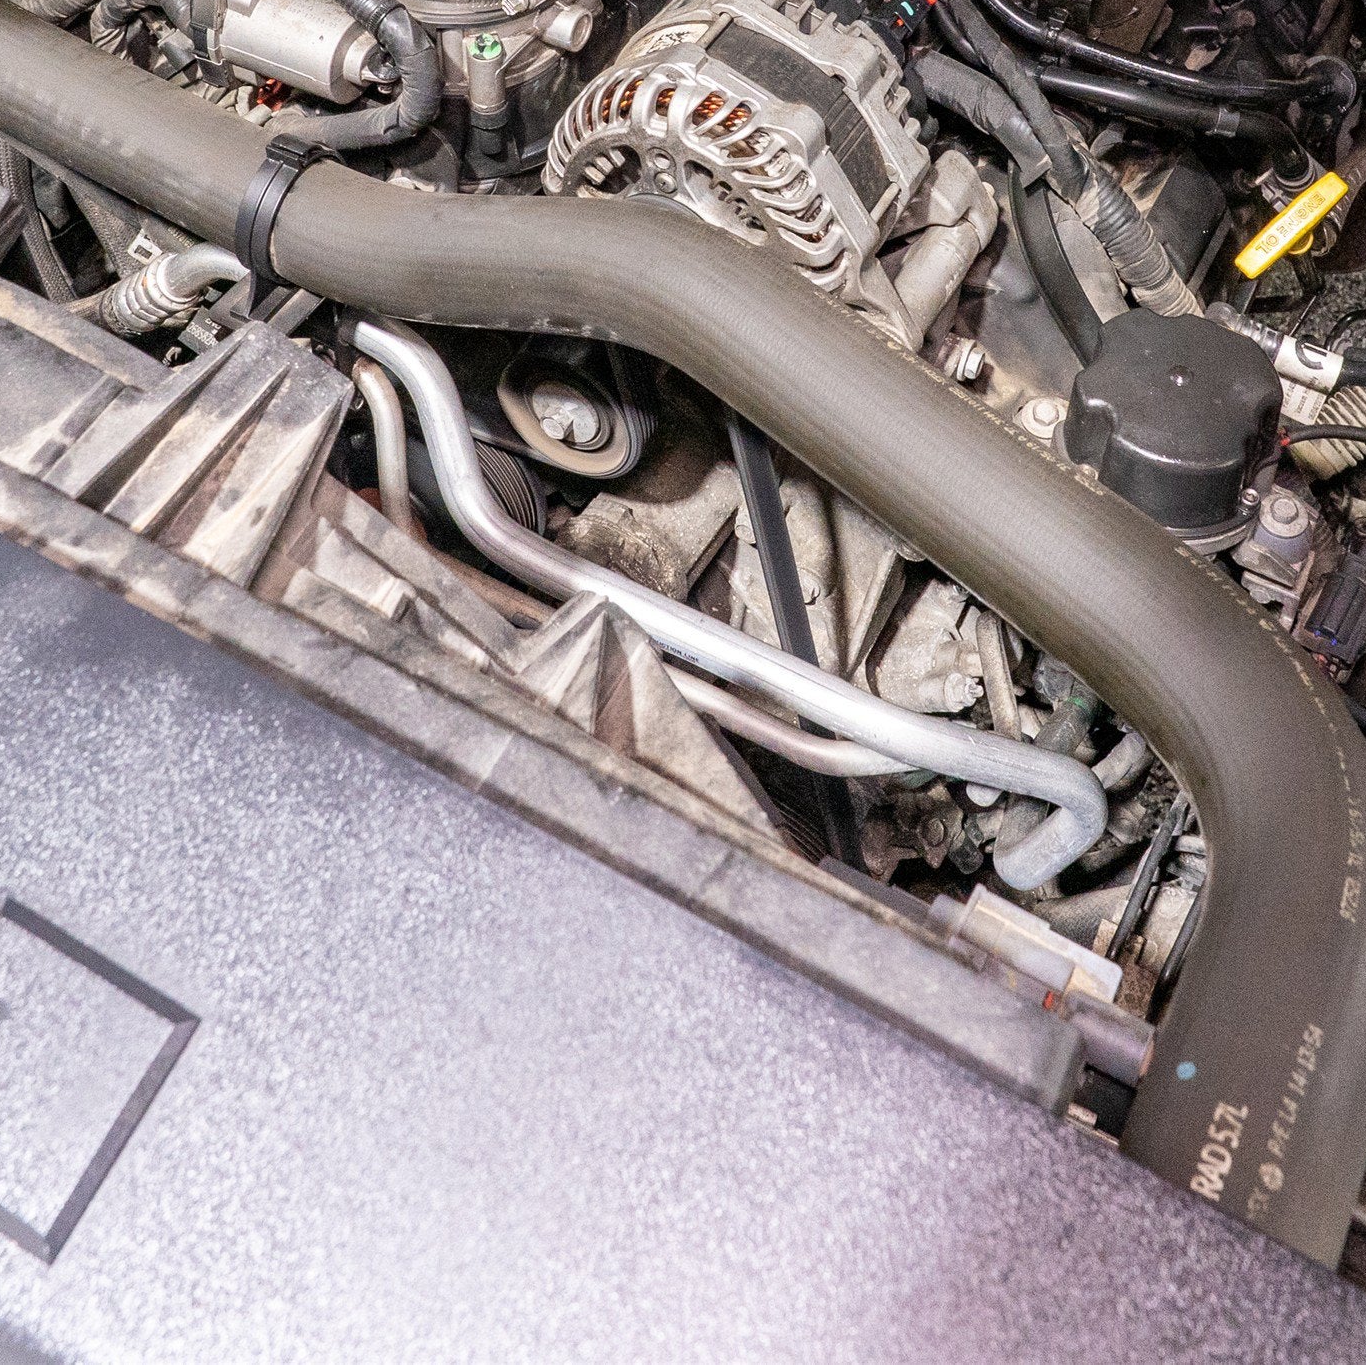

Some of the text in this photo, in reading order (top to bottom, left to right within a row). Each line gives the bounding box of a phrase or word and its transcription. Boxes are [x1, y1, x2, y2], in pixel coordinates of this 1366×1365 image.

[1254, 193, 1327, 255] ENGINE OIL
[1189, 1142, 1233, 1202] RAD
